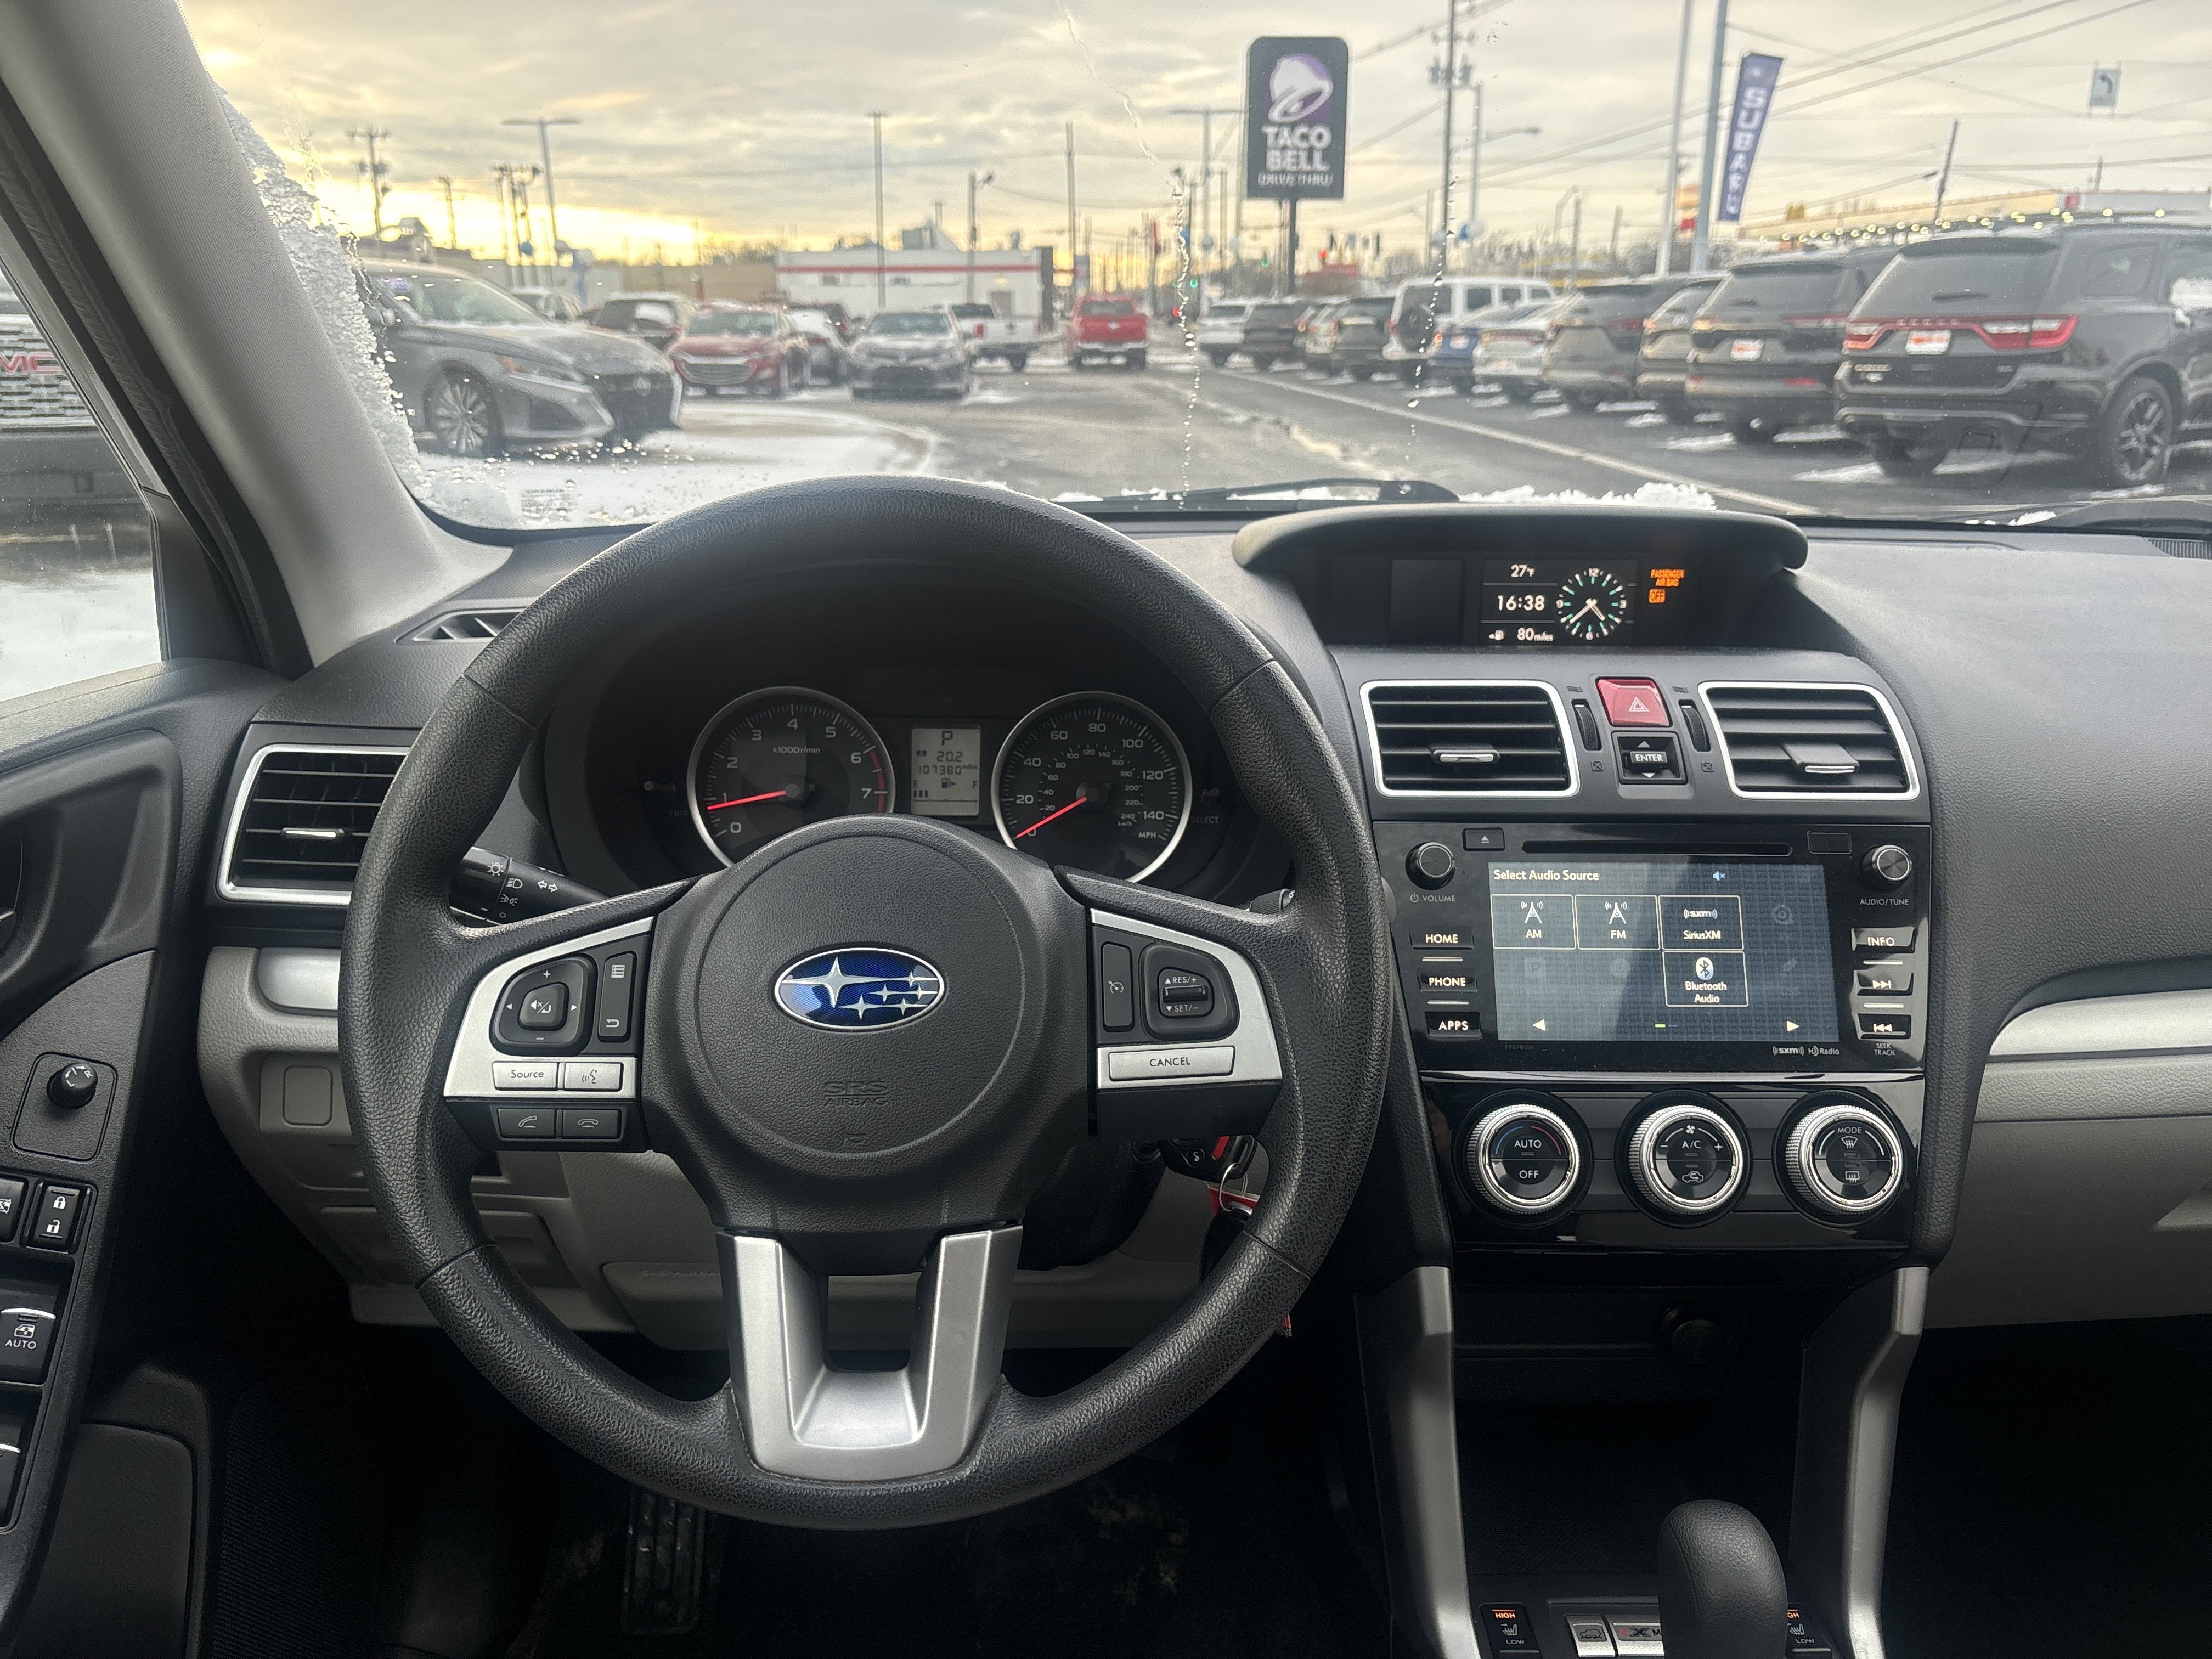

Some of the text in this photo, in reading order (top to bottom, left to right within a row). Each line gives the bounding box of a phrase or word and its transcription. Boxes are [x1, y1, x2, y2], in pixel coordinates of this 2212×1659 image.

[1262, 123, 1332, 149] TACO
[1266, 149, 1330, 172] BELL
[0, 351, 62, 374] MC
[1588, 568, 1600, 577] 12
[1497, 595, 1545, 611] 16:38
[787, 718, 798, 729] 4
[1088, 723, 1107, 733] 80
[751, 729, 763, 741] 3
[826, 726, 837, 738] 5
[1050, 731, 1068, 741] 60
[941, 731, 953, 746] P
[1122, 738, 1143, 748] 100
[726, 757, 738, 769] 2
[851, 753, 862, 764] 6
[1023, 757, 1041, 768] 40
[1635, 754, 1663, 762] ENTER
[919, 765, 962, 775] 107380
[1142, 770, 1164, 780] 120
[861, 788, 872, 799] 7
[1016, 795, 1034, 804] 20
[1143, 810, 1164, 820] 140
[730, 822, 742, 834] 0
[1493, 870, 1599, 881] Select Audio Source
[1860, 898, 1909, 906] AUDIO/TUNE
[1526, 929, 1542, 938] AM
[1611, 930, 1626, 939] FM
[1683, 930, 1721, 940] SiriusXM
[1425, 934, 1458, 944] HOME
[1867, 937, 1894, 946] INFO
[1429, 977, 1466, 987] PHONE
[1685, 981, 1727, 991] Bluetooth
[1694, 994, 1720, 1003] Audio
[1438, 1021, 1468, 1031] APPS
[1149, 1057, 1190, 1067] CANCEL
[511, 1069, 544, 1079] Source
[823, 1081, 888, 1094] SRS
[824, 1098, 888, 1106] AIRBAG
[1837, 1126, 1862, 1134] MODE
[1514, 1139, 1542, 1149] AUTO
[1681, 1140, 1701, 1149] A/C
[1519, 1170, 1539, 1179] OFF
[5, 1339, 37, 1349] AUTO
